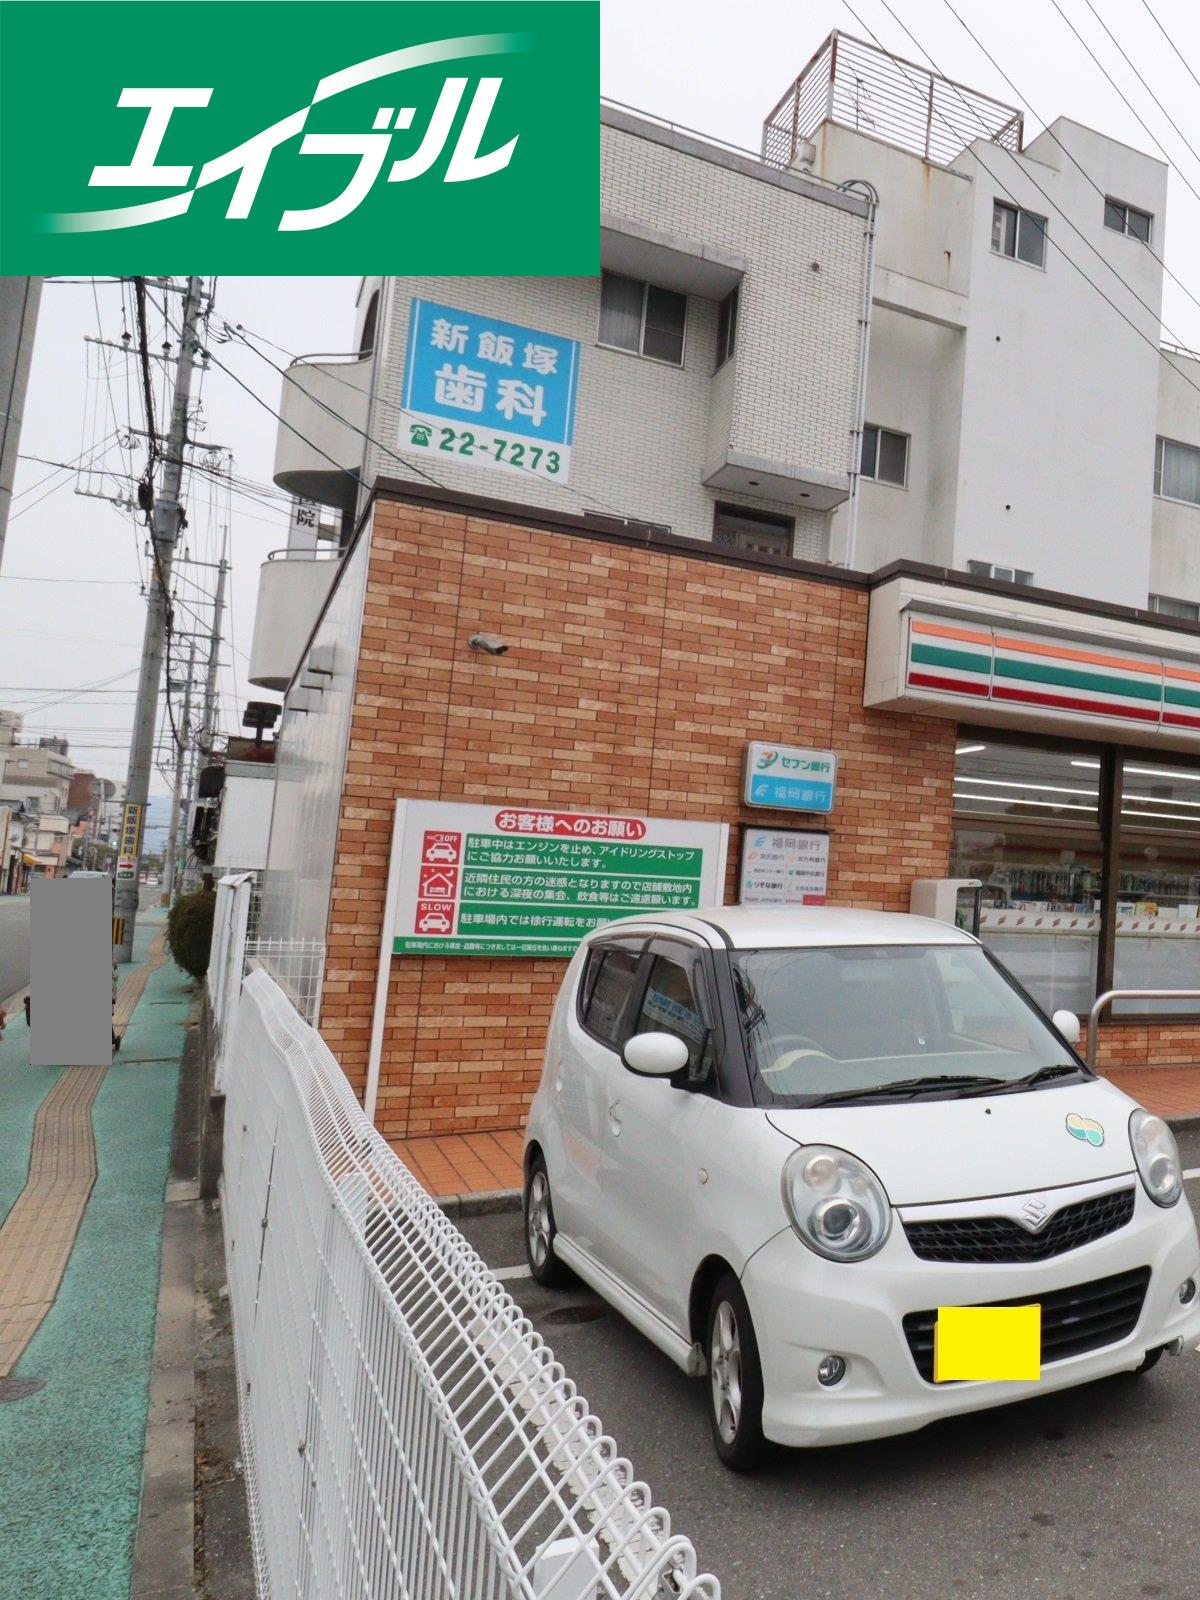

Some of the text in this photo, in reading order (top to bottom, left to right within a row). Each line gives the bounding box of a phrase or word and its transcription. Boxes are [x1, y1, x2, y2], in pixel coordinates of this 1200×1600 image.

[430, 318, 559, 376] 新飯塚
[434, 363, 548, 427] 歯科
[439, 426, 562, 475] 22-7273
[781, 756, 831, 773] セブン銀行
[774, 786, 827, 803] 福岡銀行
[499, 812, 643, 838] お客様へのお願い
[444, 834, 458, 842] OFF
[468, 837, 695, 860] 駐車中はエンジンを止め、アイドリングストップ
[467, 851, 607, 869] にご協力お願いいたします。
[420, 903, 452, 911] SLOW
[460, 913, 611, 928] 駐車場内では徐行運転をお願
